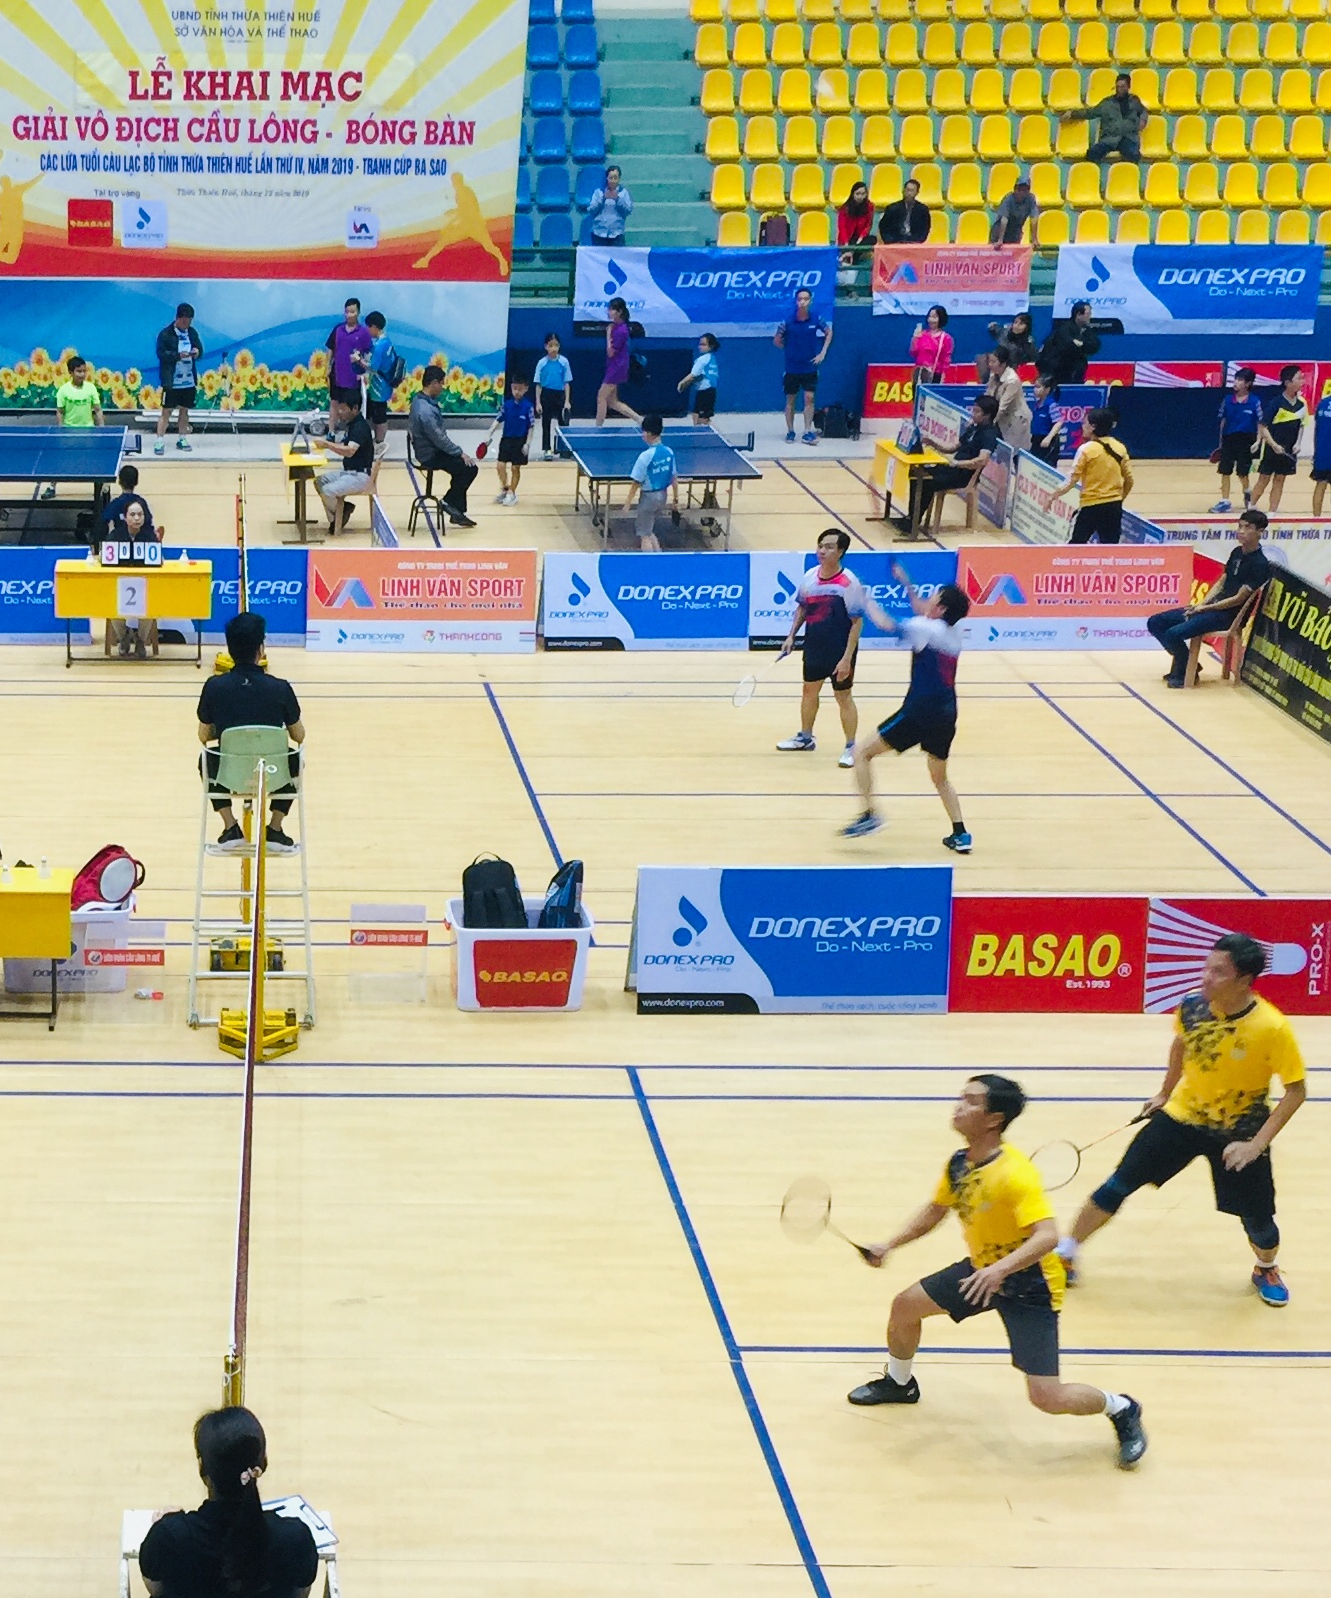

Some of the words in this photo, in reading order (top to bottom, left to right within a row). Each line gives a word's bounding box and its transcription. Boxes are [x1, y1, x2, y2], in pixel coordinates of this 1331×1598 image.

[171, 11, 201, 21] UBND
[263, 10, 295, 22] THIÊN
[297, 9, 321, 22] HUẾ
[289, 27, 319, 39] THAO
[128, 55, 172, 101] LỄ
[183, 70, 270, 101] KHAI
[280, 70, 363, 108] MẠC
[12, 106, 68, 142] GIẢI
[74, 109, 109, 142] VÔ
[115, 117, 180, 148] ĐỊCH
[186, 109, 241, 144] CẦU
[248, 112, 319, 145] LÔNG
[346, 112, 418, 145] BÓNG
[424, 113, 476, 146] BÀN
[40, 152, 58, 172] CÁC
[123, 155, 140, 176] LẠC
[144, 152, 156, 176] BỘ
[206, 152, 233, 174] THIÊN
[235, 151, 253, 174] HUẾ
[276, 153, 293, 174] THỨ
[331, 158, 354, 175] 2019
[363, 158, 392, 176] TRANH
[394, 154, 412, 175] CÚP
[414, 158, 427, 175] BA
[429, 158, 447, 175] SAO
[982, 262, 1023, 277] SPORT
[873, 381, 913, 403] BAS
[1167, 529, 1198, 541] TRUNG
[105, 544, 115, 562] 3
[122, 546, 127, 557] 0
[149, 544, 157, 562] 0
[380, 578, 421, 597] LINH
[426, 573, 462, 597] VÂN
[467, 577, 524, 597] SPORT
[1034, 575, 1075, 593] LINH
[1081, 570, 1117, 593] VÂN
[1122, 574, 1181, 593] SPORT
[125, 586, 137, 606] 2
[816, 940, 840, 953] Do
[851, 940, 891, 952] Next
[903, 940, 933, 951] Pro
[966, 933, 1122, 977] BASAO
[1309, 922, 1325, 996] PRO-X
[492, 971, 567, 983] BASAO
[1065, 979, 1111, 989] Est.1993
[642, 998, 725, 1010] www.donexpro.com
